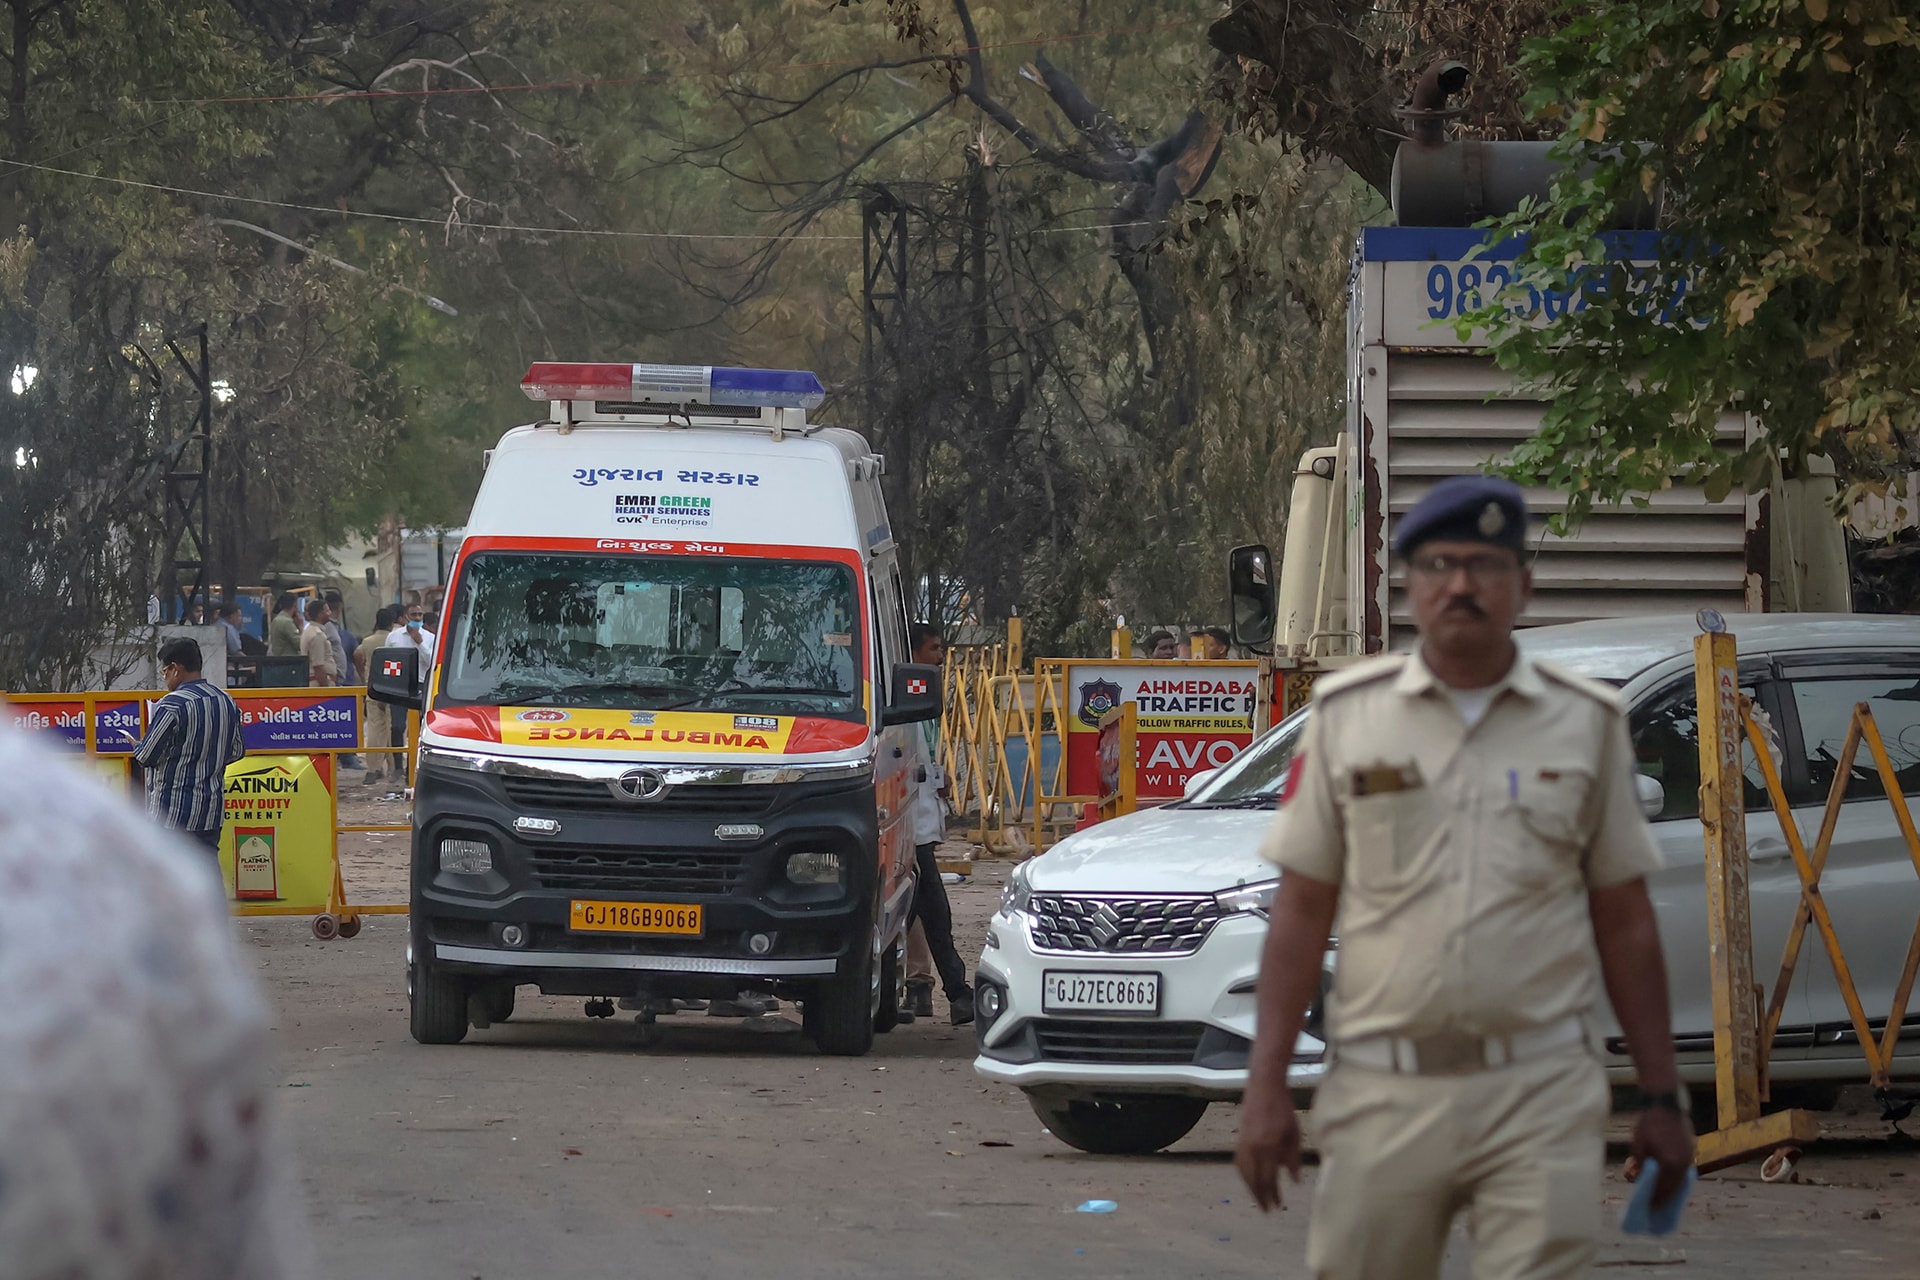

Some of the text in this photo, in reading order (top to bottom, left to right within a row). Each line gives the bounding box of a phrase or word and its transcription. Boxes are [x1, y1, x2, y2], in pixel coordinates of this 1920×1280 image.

[573, 469, 760, 487] ગુજરાત સરકાર
[615, 495, 711, 508] EMRI GREEN
[615, 506, 710, 516] HEALTH SERVICES
[617, 516, 708, 526] GVK Enterprise
[684, 542, 724, 553] સેવા
[1136, 680, 1255, 695] AHMEDABA
[1136, 696, 1236, 712] TRAFFIC
[55, 711, 98, 728] પોલી
[257, 706, 303, 723] પોલીસ
[308, 705, 352, 722] સ્ટેશન
[735, 716, 777, 726] 108
[1173, 719, 1211, 728] TRAFFIC
[1214, 720, 1247, 730] RULES,
[223, 777, 299, 793] ATINUM
[1145, 774, 1188, 786] WIR
[224, 798, 291, 809] EAVY DUTY
[224, 811, 283, 820] CEMENT
[585, 906, 697, 928] GJ18GB9068
[1057, 979, 1155, 1004] GJ27EC8663
